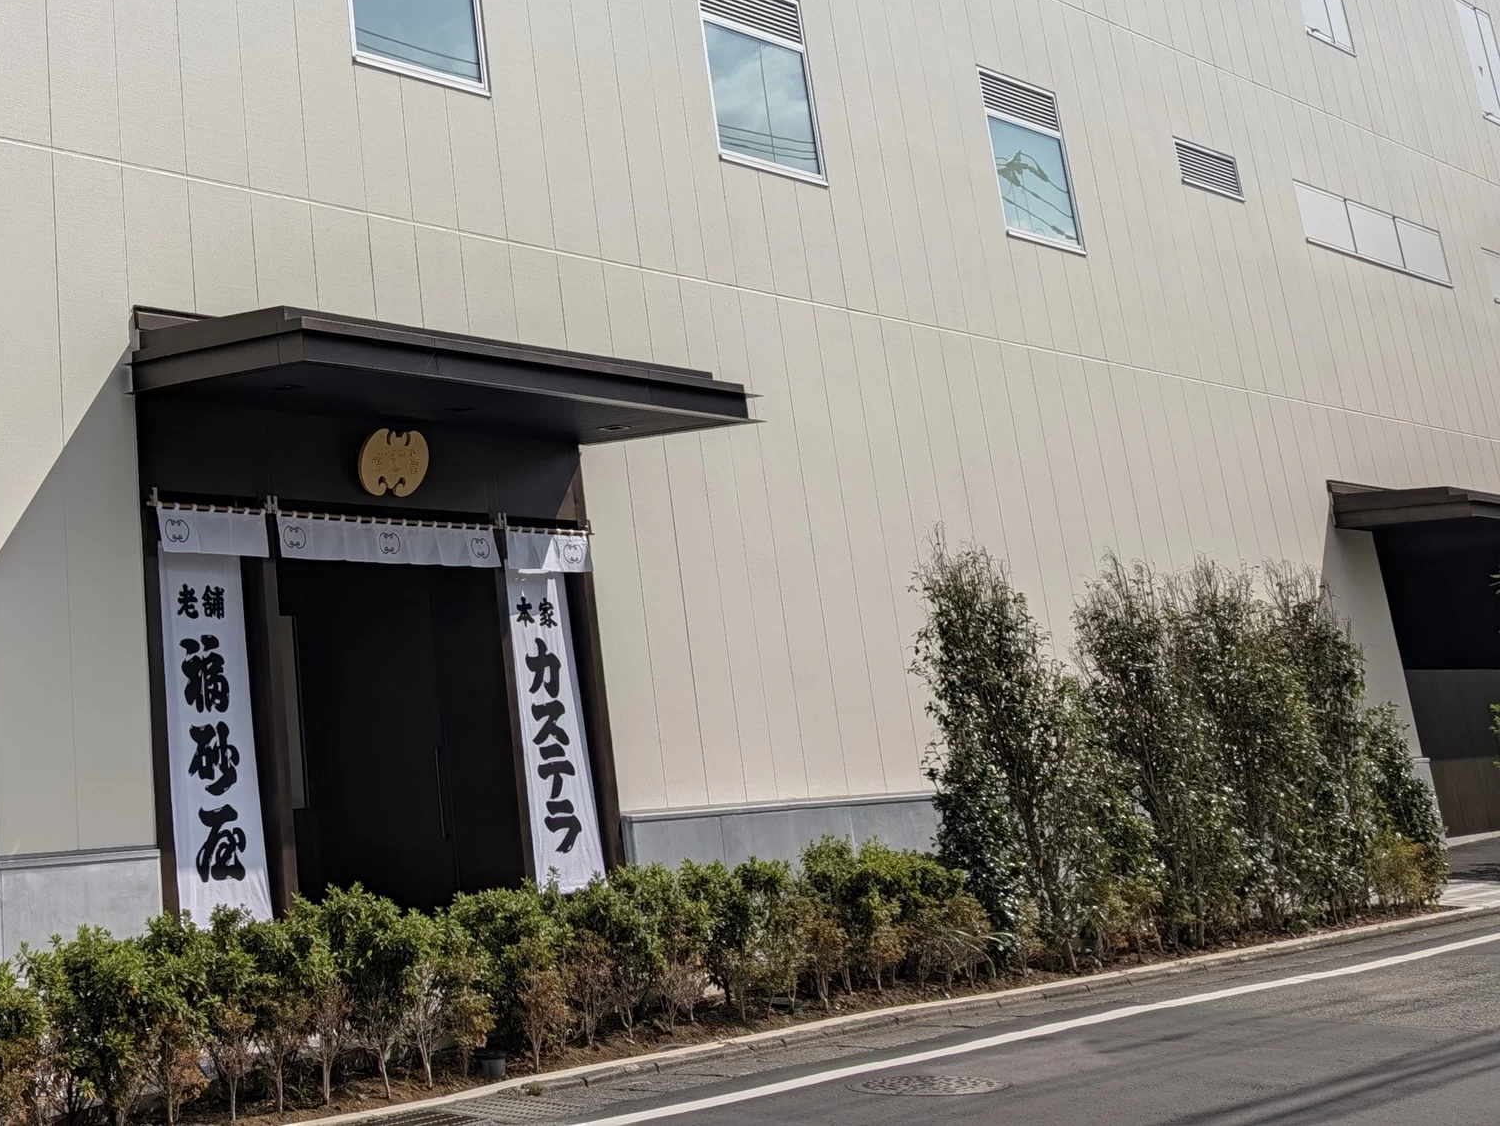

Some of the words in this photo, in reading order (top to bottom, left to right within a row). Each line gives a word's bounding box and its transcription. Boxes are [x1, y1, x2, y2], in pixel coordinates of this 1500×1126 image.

[177, 583, 225, 620] 老舗
[515, 596, 558, 629] 本家
[179, 634, 247, 883] 福砂屋
[525, 637, 583, 854] カステラ
